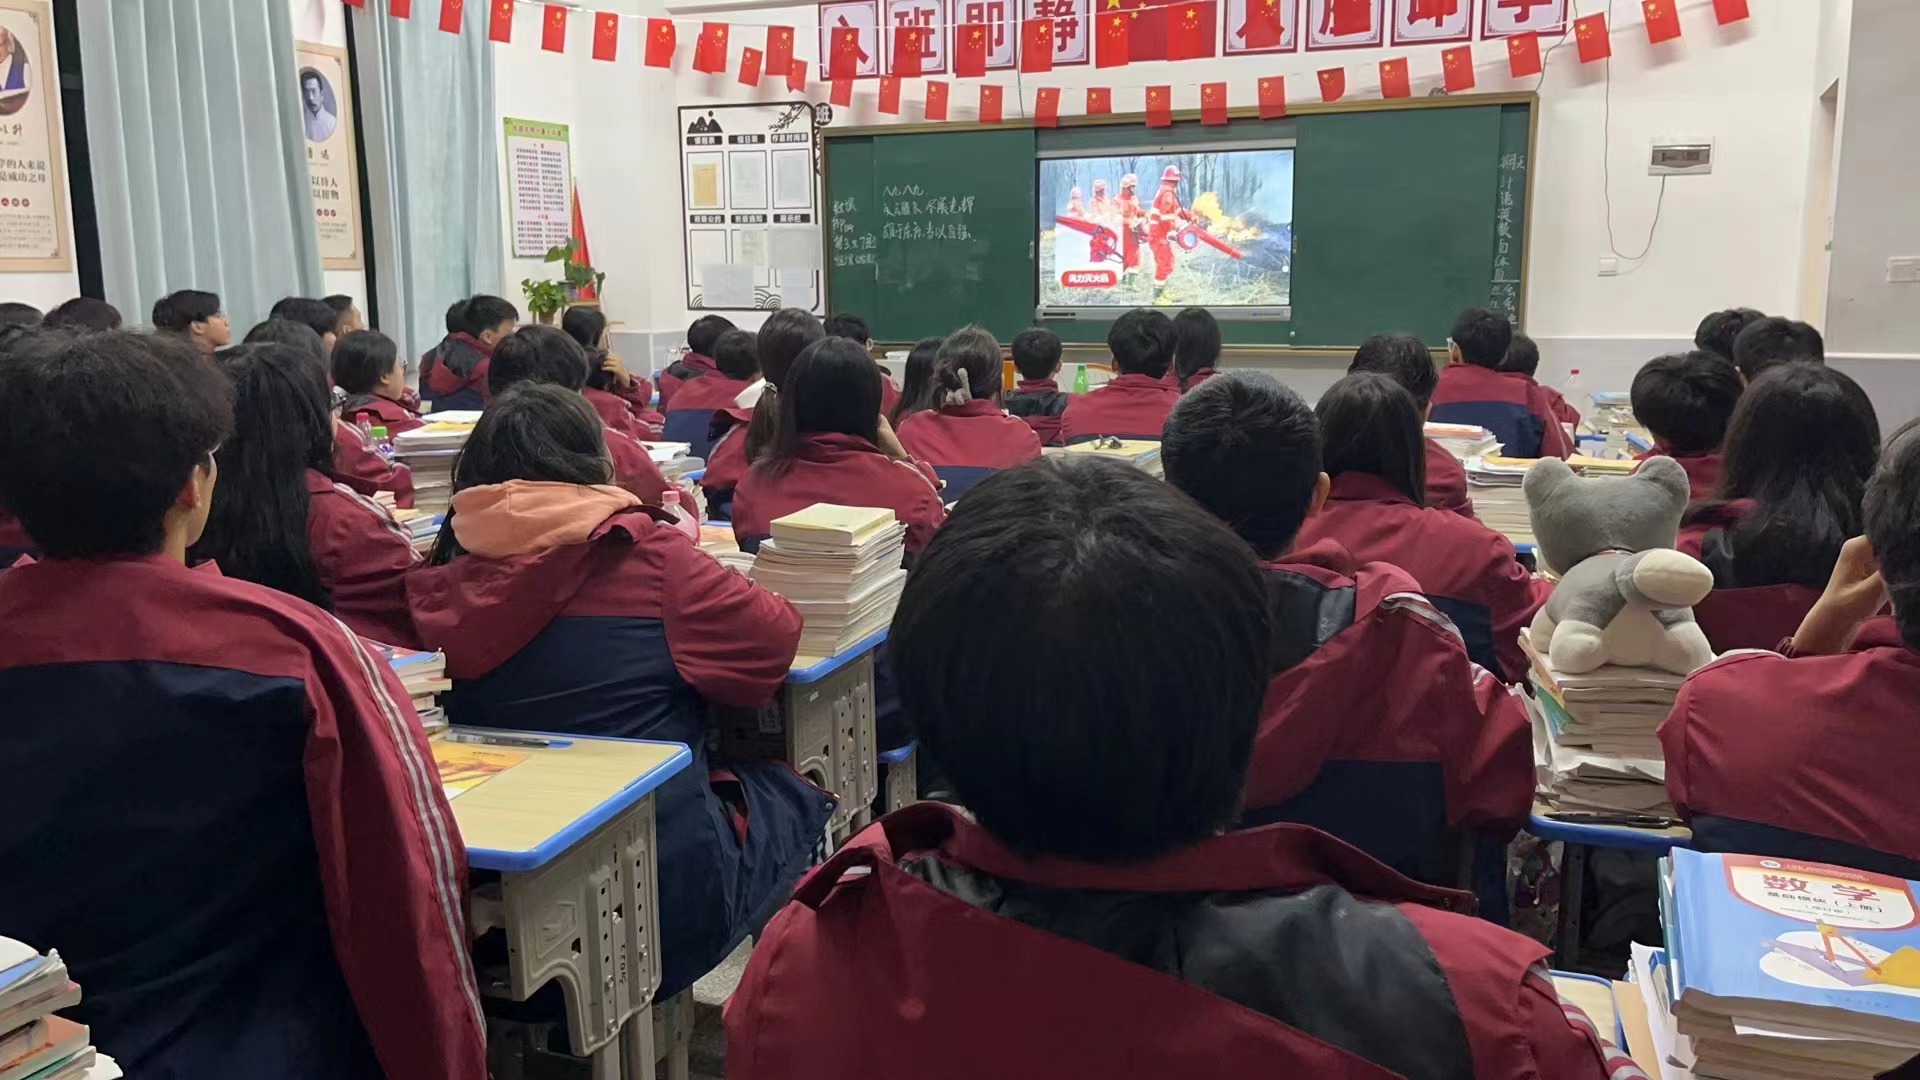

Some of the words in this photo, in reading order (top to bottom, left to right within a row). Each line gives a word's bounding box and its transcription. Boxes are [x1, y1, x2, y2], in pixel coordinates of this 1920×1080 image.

[815, 105, 831, 123] 班
[772, 133, 808, 142] 作息时间表
[780, 214, 802, 223] 展示栏
[1068, 272, 1110, 283] 风力灭火机
[1762, 874, 1881, 902] 数学
